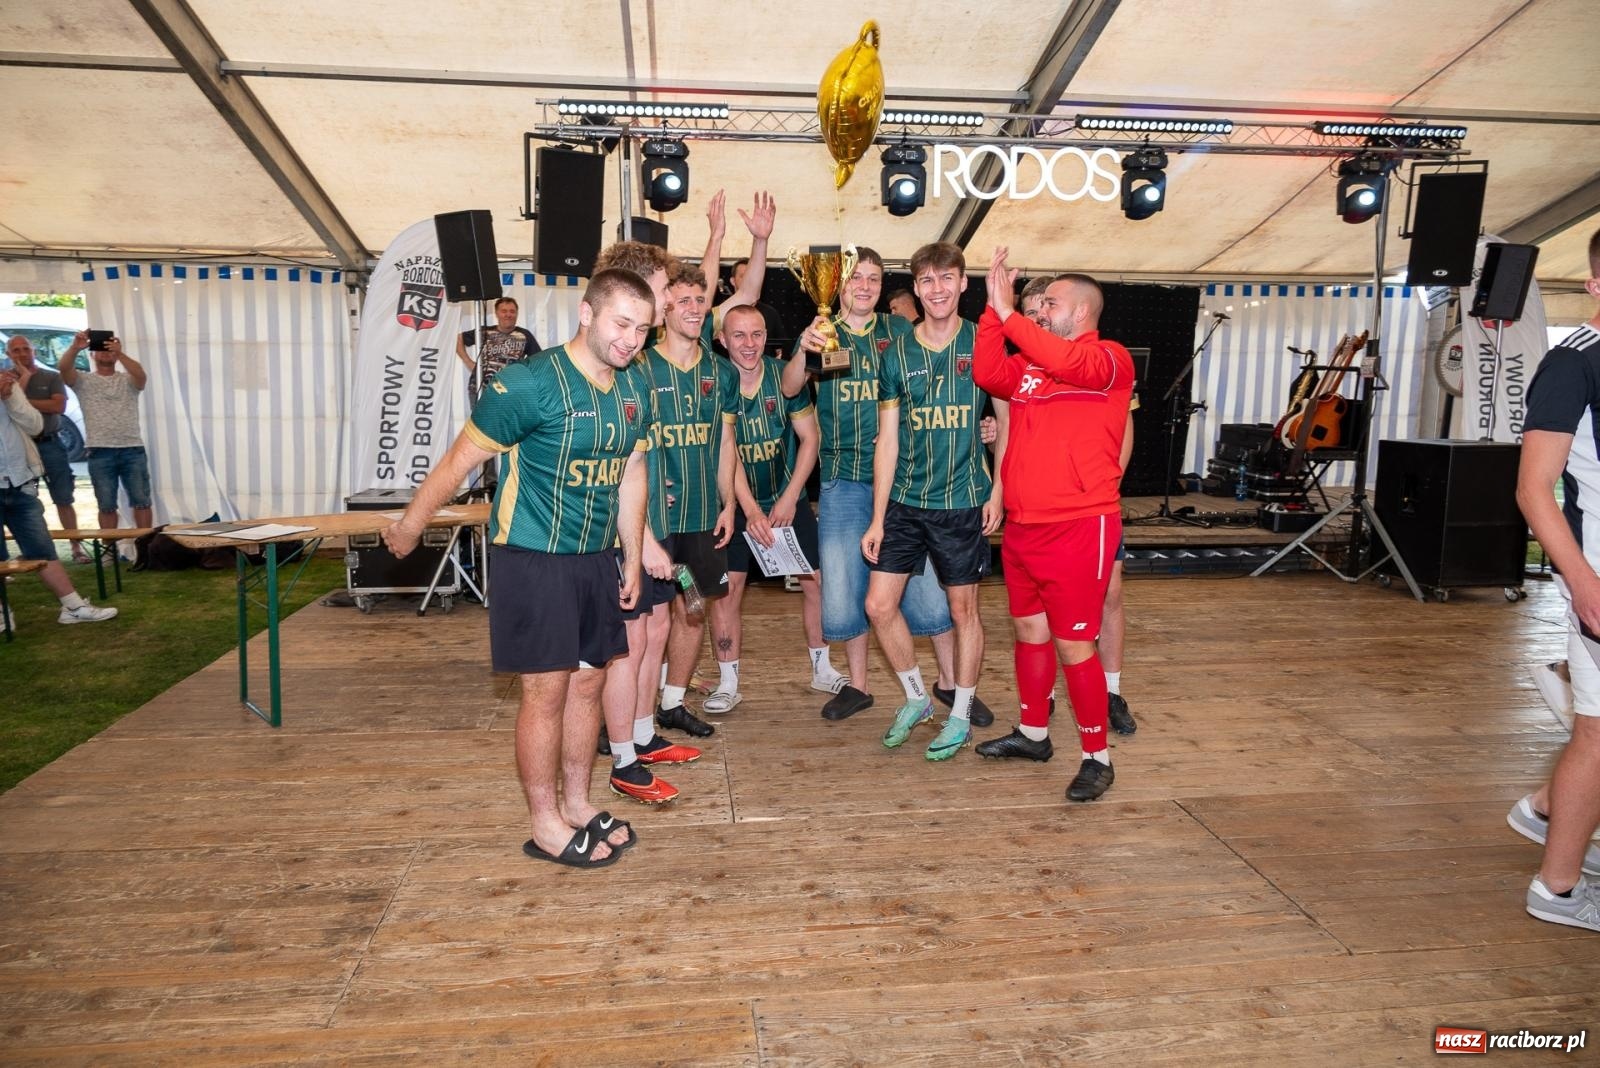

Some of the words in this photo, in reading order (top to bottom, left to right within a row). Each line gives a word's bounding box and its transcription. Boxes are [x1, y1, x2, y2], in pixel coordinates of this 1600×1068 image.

[932, 144, 1121, 201] RODOS
[394, 256, 443, 271] NAPRZ
[403, 294, 437, 317] KS
[861, 355, 871, 374] 4
[412, 347, 439, 446] BORUCIN
[935, 374, 944, 399] 7
[376, 355, 405, 480] SPORTOWY
[571, 410, 597, 418] zina
[683, 394, 693, 417] 3
[910, 404, 972, 431] START
[604, 422, 616, 451] 2
[662, 422, 712, 447] START
[748, 416, 764, 437] 11
[405, 455, 430, 489] ÓD
[784, 531, 808, 572] DYPLOM
